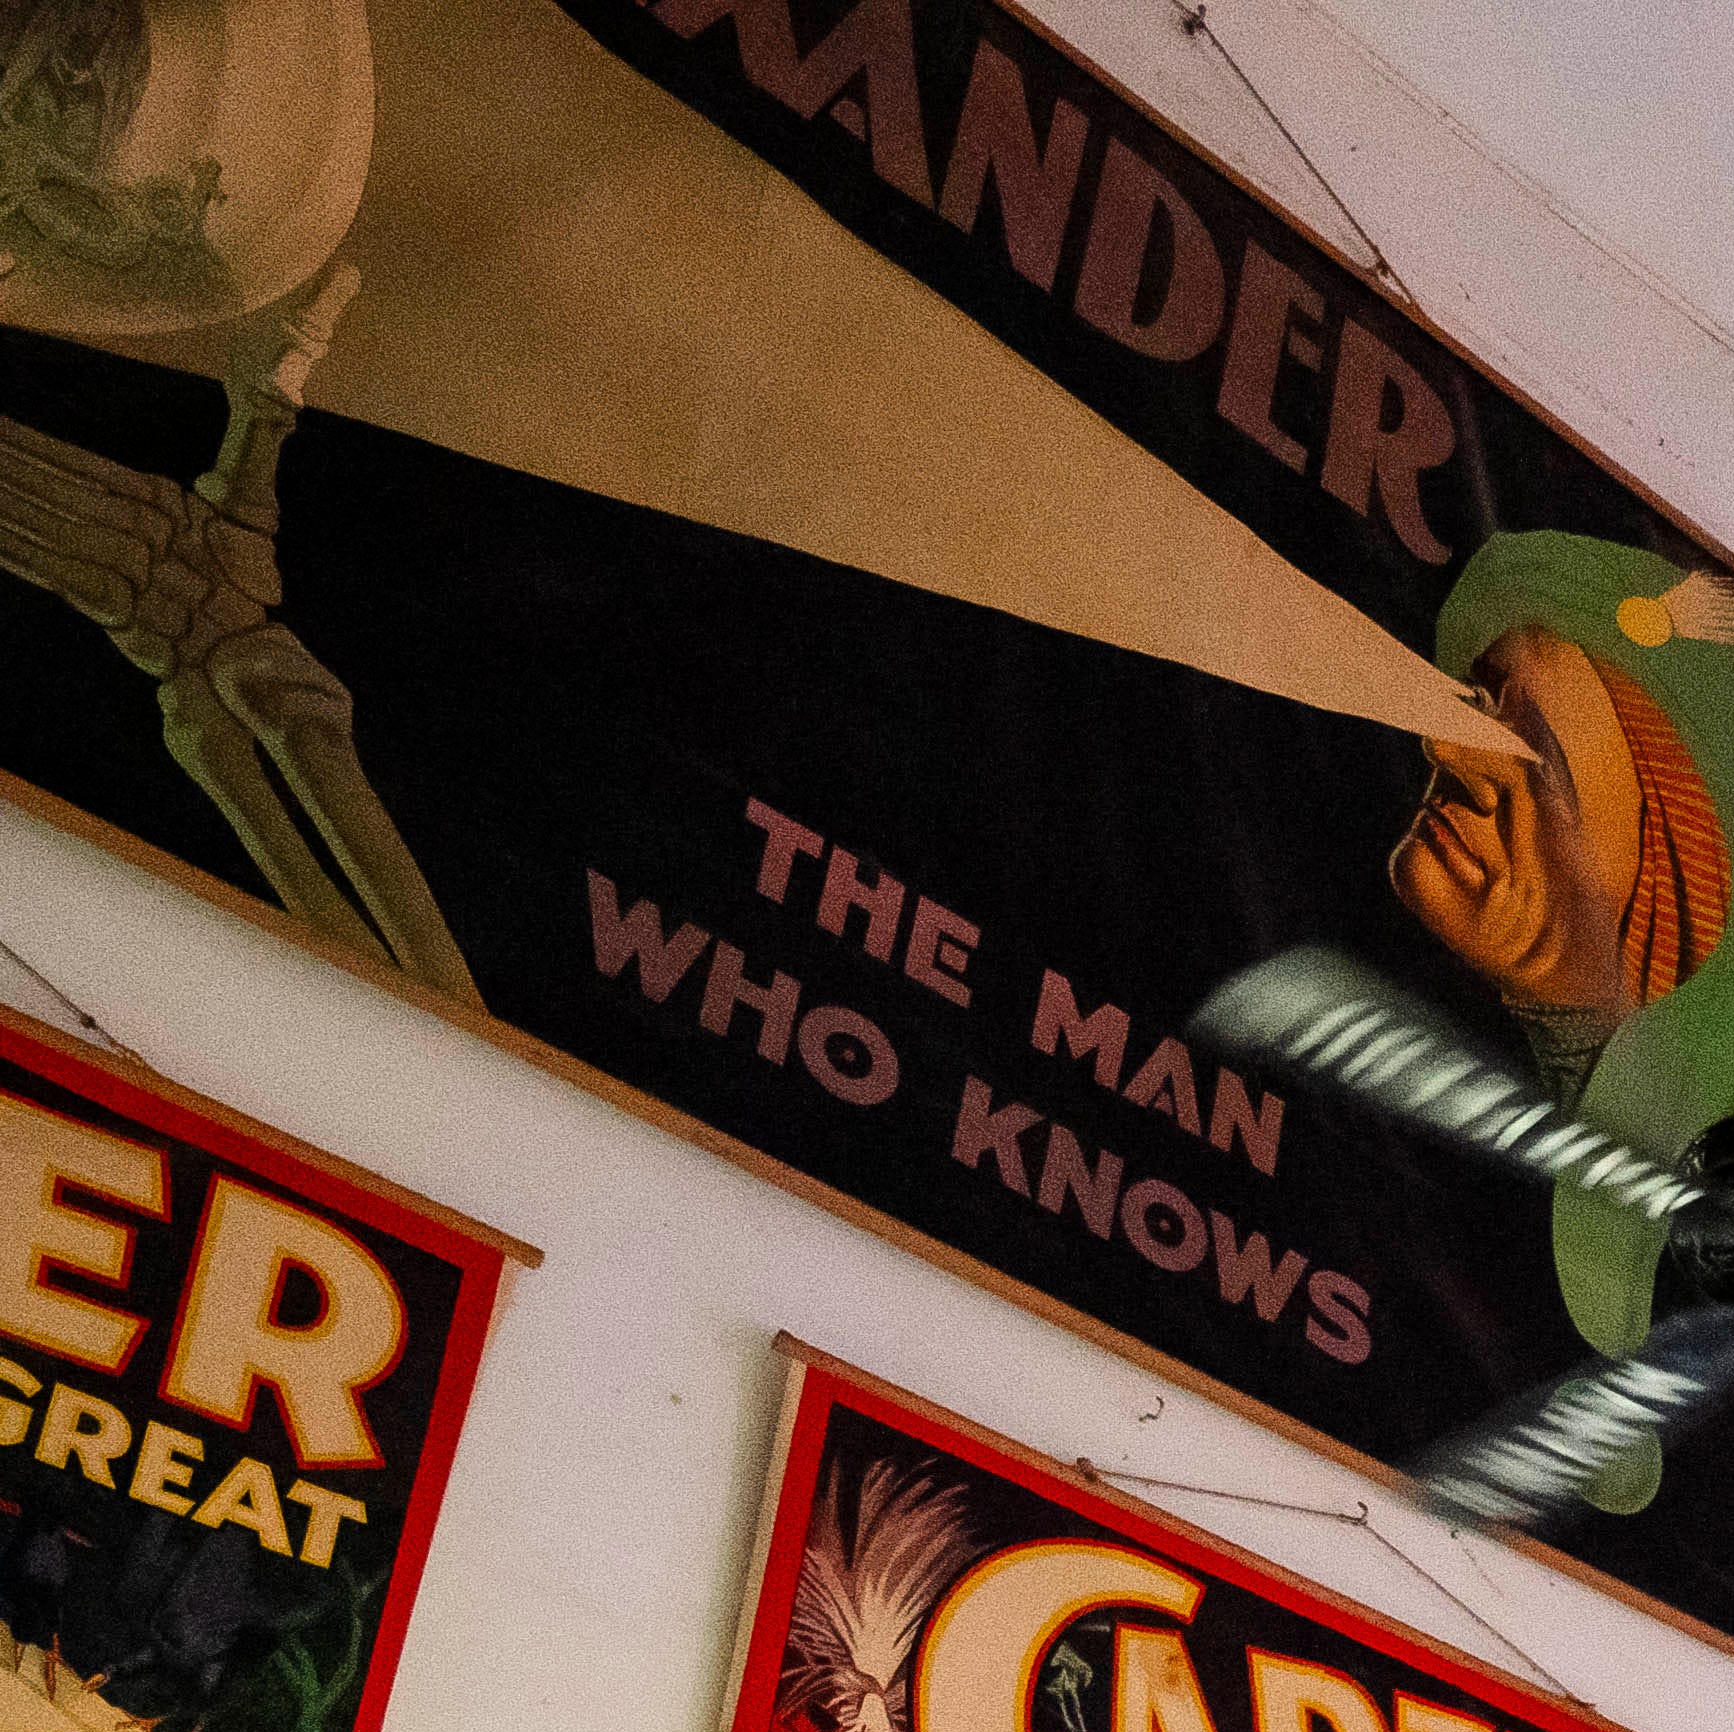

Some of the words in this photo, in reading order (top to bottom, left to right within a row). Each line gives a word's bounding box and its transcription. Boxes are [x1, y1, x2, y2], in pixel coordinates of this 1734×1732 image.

[586, 867, 900, 1108] WHO
[951, 1082, 1373, 1366] KNOWS
[746, 799, 982, 1007] THE
[1029, 966, 1286, 1178] MAN
